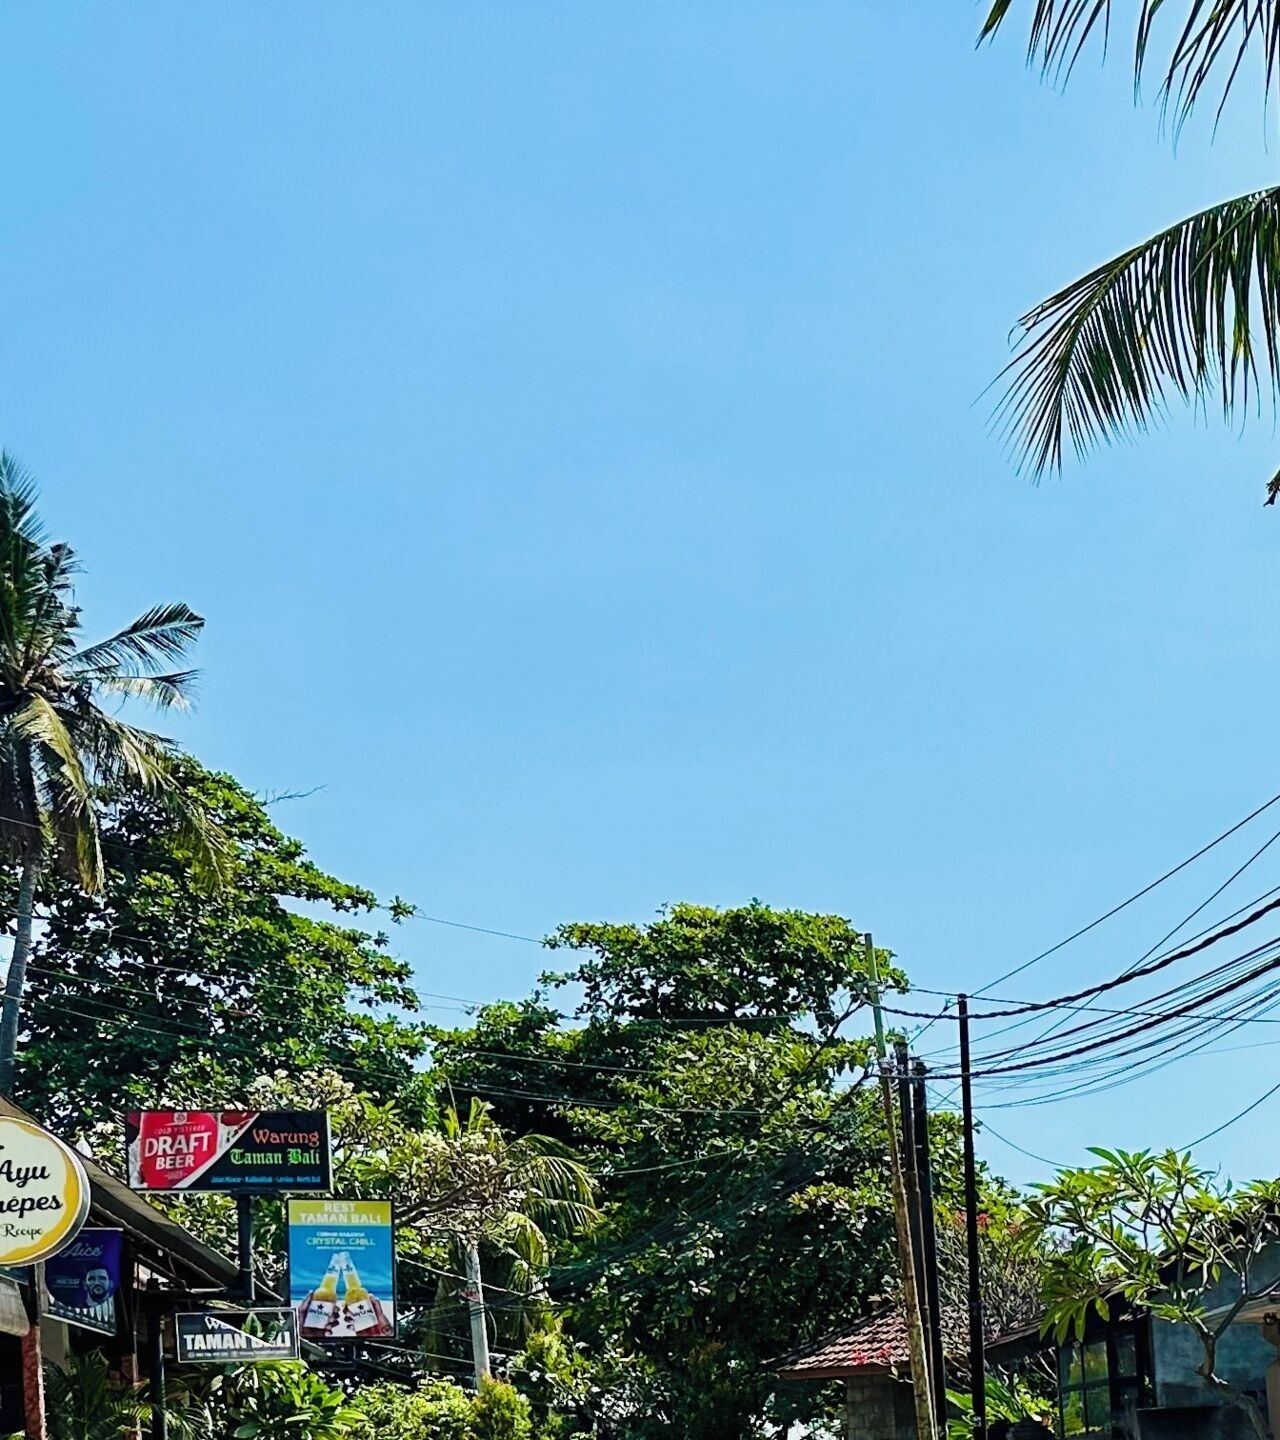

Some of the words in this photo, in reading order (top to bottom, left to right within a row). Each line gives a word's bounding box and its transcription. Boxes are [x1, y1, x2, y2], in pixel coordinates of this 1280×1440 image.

[144, 1132, 212, 1157] DRAFT
[252, 1128, 320, 1147] Warung
[155, 1154, 195, 1170] BEER
[229, 1148, 282, 1165] Taman
[287, 1147, 321, 1166] Bali
[0, 1159, 50, 1188] Ayu
[324, 1202, 356, 1213] REST
[299, 1213, 345, 1224] TAMAN
[351, 1213, 382, 1224] BALI
[0, 1223, 43, 1240] Recipe
[59, 1242, 102, 1257] Aice
[306, 1236, 346, 1246] CRYSTAL
[183, 1332, 246, 1351] TAMAN
